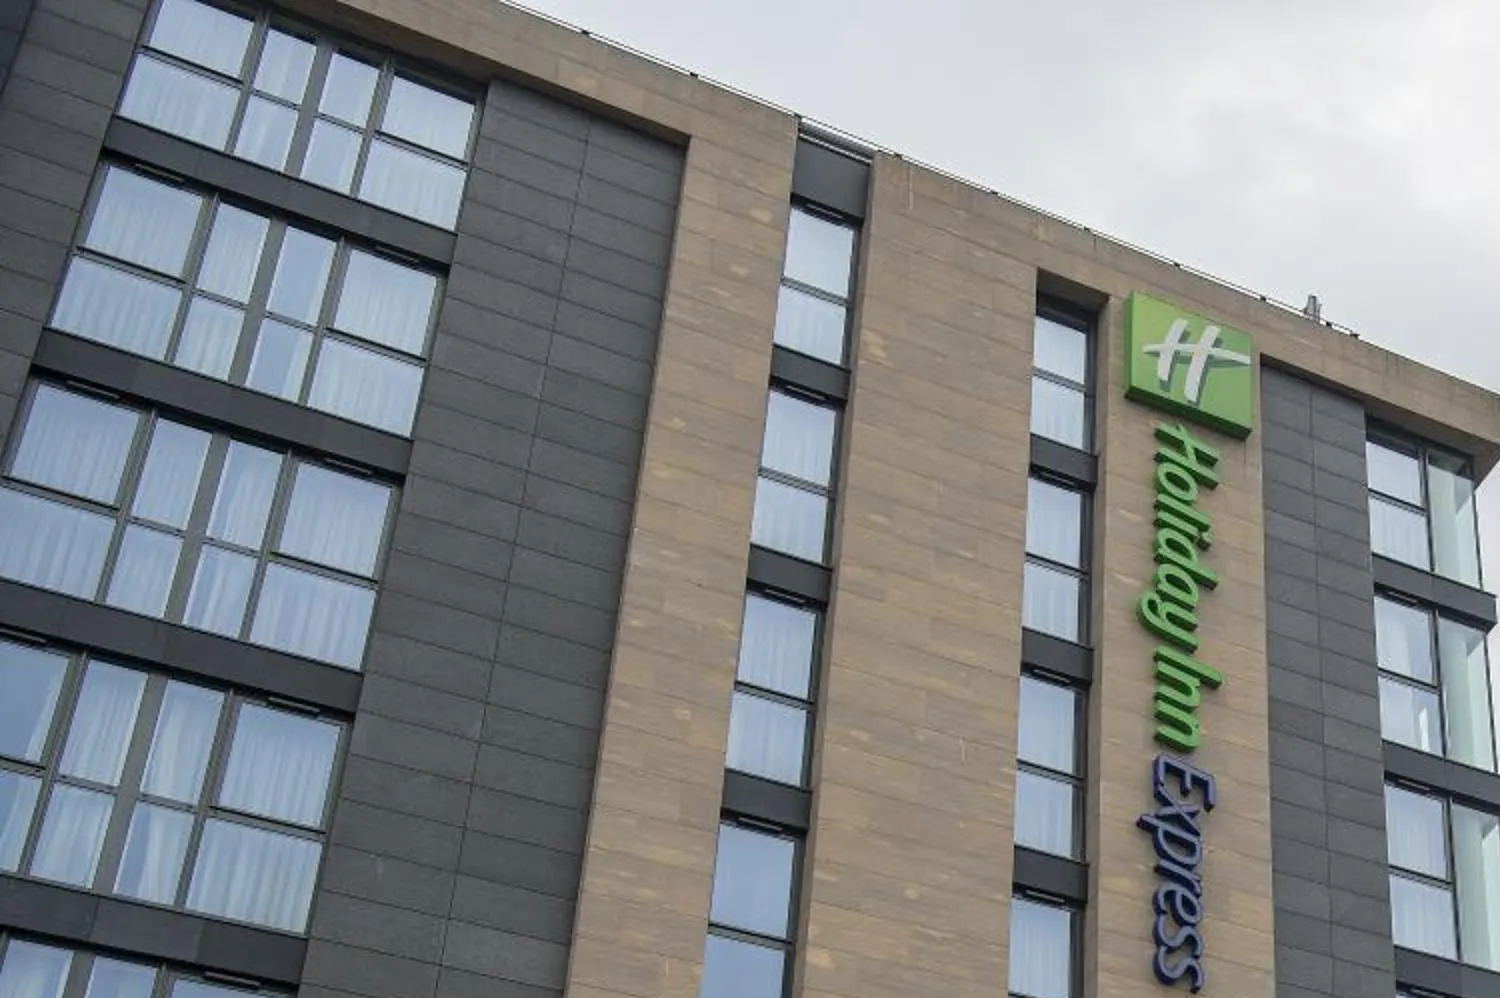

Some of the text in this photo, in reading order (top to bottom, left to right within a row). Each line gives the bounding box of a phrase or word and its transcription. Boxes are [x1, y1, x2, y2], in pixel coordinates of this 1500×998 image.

[1143, 318, 1251, 402] H
[1136, 422, 1222, 994] Holiday Inn Express
